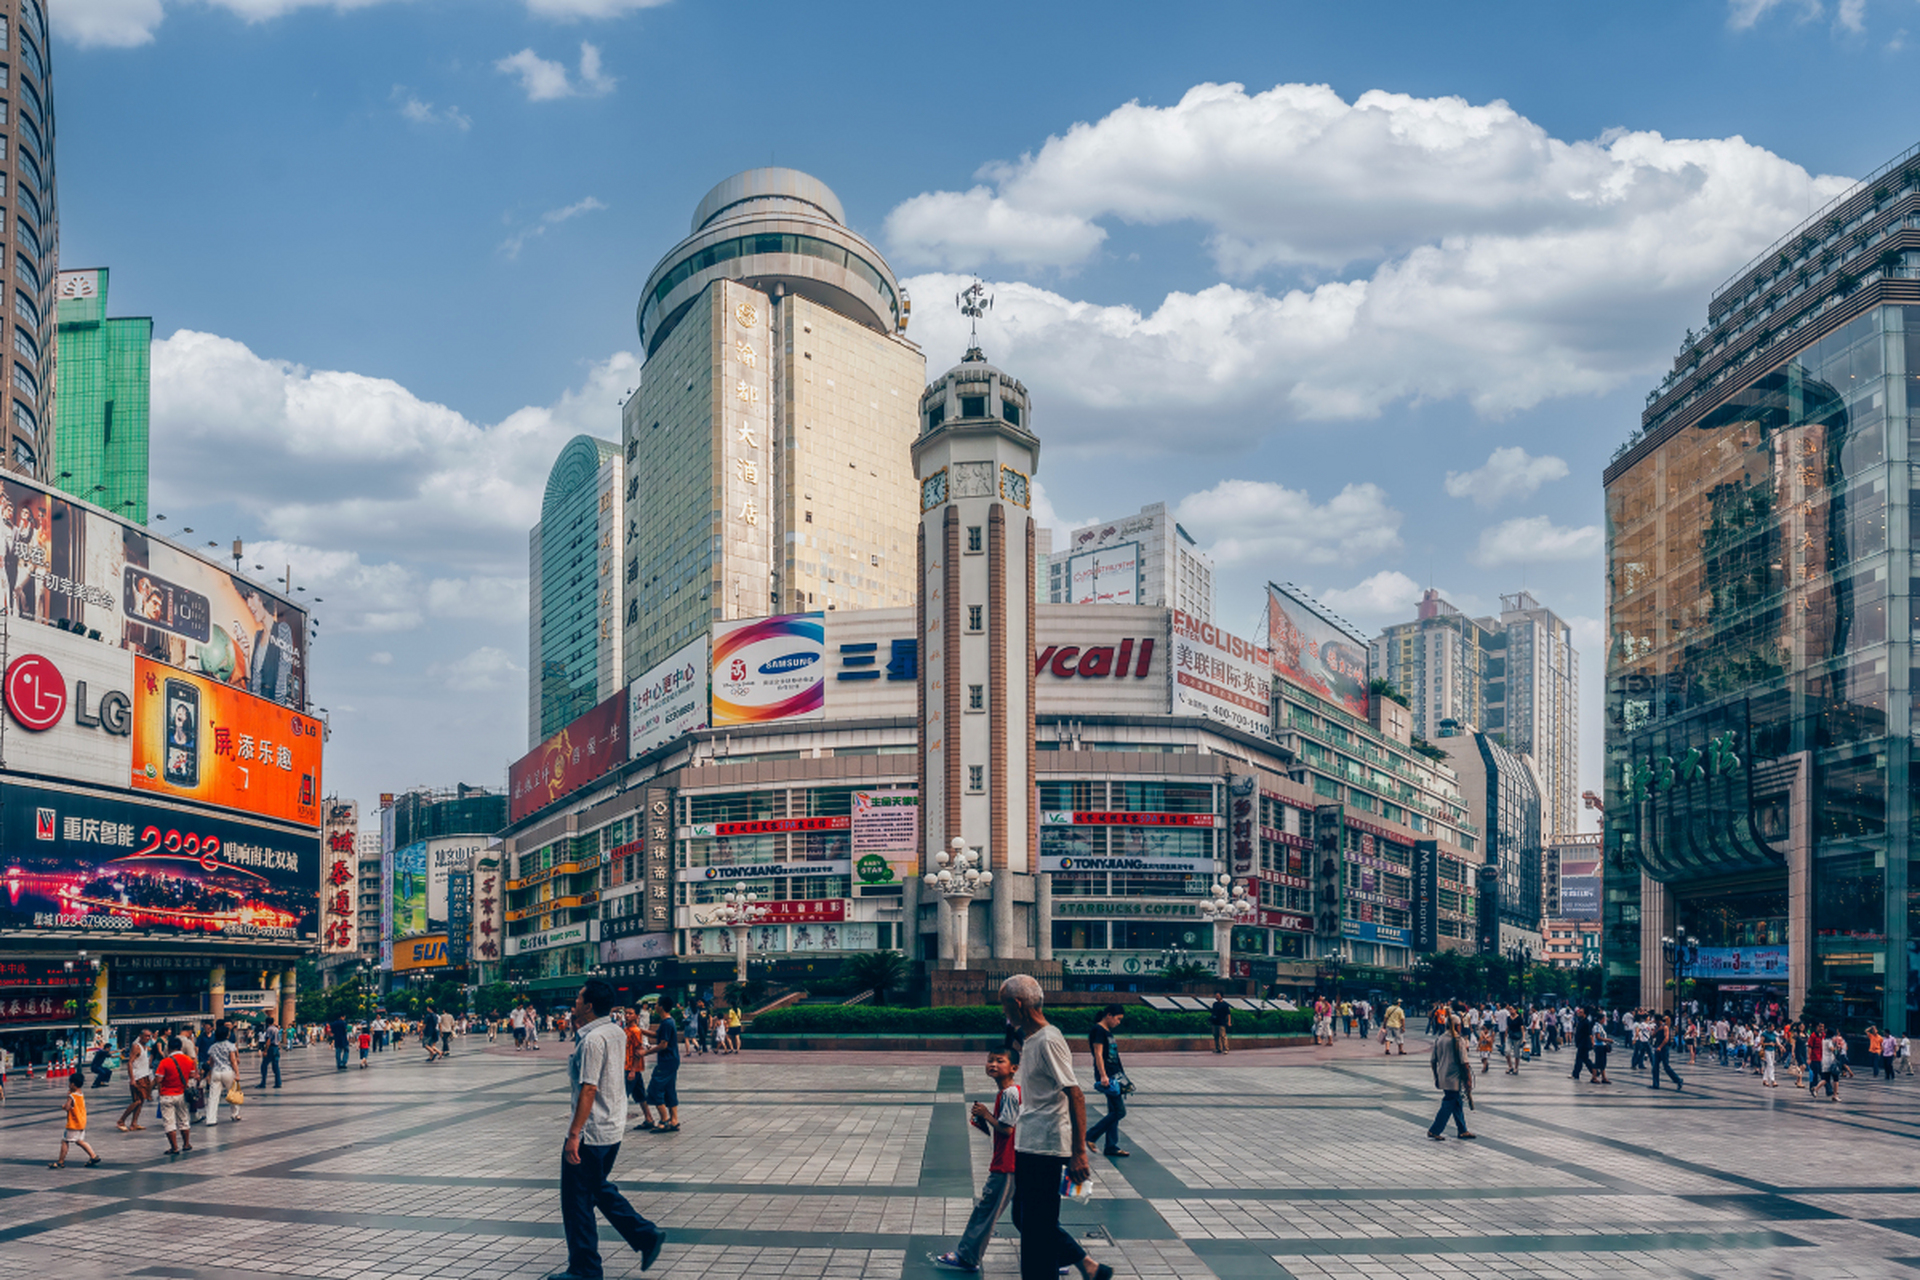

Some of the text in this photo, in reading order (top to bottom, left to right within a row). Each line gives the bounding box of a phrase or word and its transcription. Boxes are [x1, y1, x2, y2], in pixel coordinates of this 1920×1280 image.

[735, 340, 759, 527] 渝都大酒店
[1174, 608, 1256, 665] ENGLISH
[765, 656, 814, 670] SAMSUNG
[1177, 643, 1270, 701] 美联国际英语
[75, 680, 131, 736] LG
[305, 724, 316, 737] LG
[63, 816, 135, 847] 重庆鲁能
[223, 842, 299, 873] 唱响南北双城
[1074, 858, 1143, 870] TONYJIANG
[718, 864, 783, 878] TONYJIANG
[714, 886, 768, 895] TONYIANG
[1419, 849, 1430, 945] Meters/bonwe
[1059, 904, 1196, 915] STARBUCKS COFFEE
[1281, 915, 1302, 929] KFC
